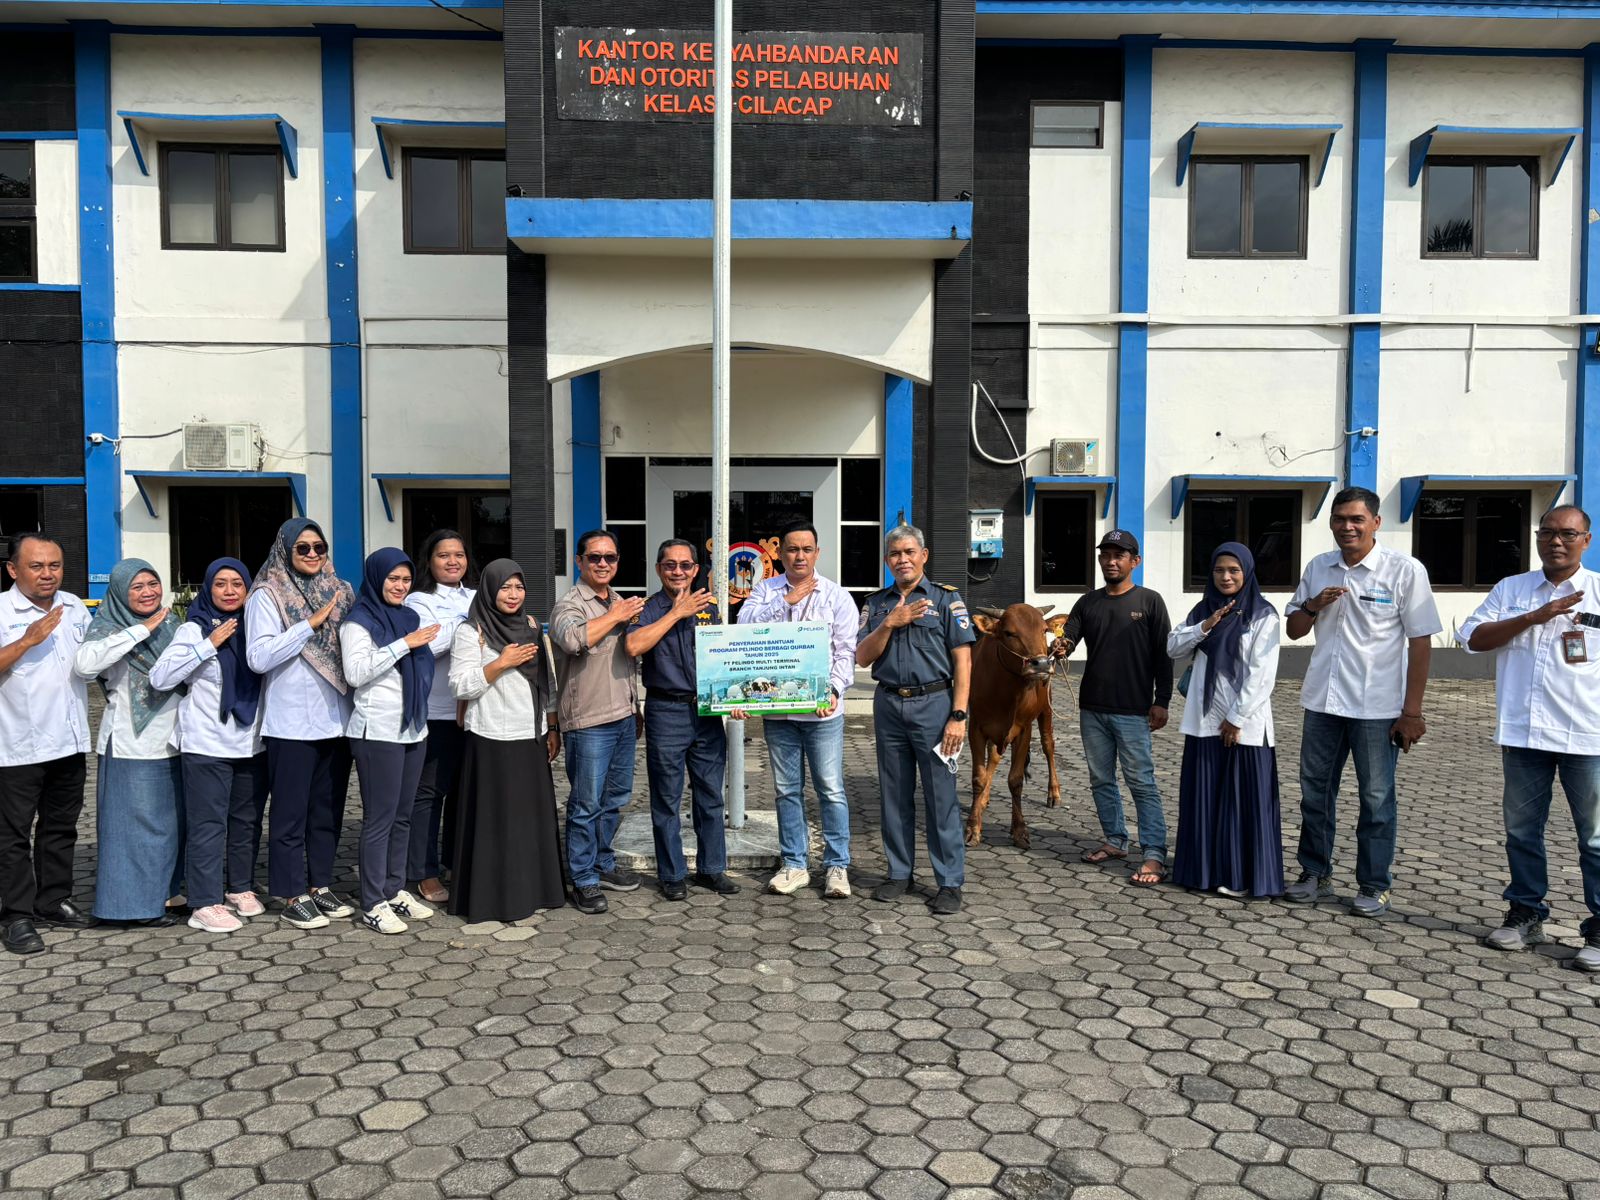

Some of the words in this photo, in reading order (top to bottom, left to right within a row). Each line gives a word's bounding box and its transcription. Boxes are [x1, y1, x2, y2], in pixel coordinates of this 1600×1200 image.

[577, 40, 675, 60] KANTOR
[683, 42, 899, 65] KEYAHBANDARAN
[590, 66, 636, 86] DAN
[640, 67, 750, 89] OTORITS
[755, 69, 890, 91] PELABUHAN
[643, 93, 716, 114] KELAS
[738, 95, 833, 115] CILACAP
